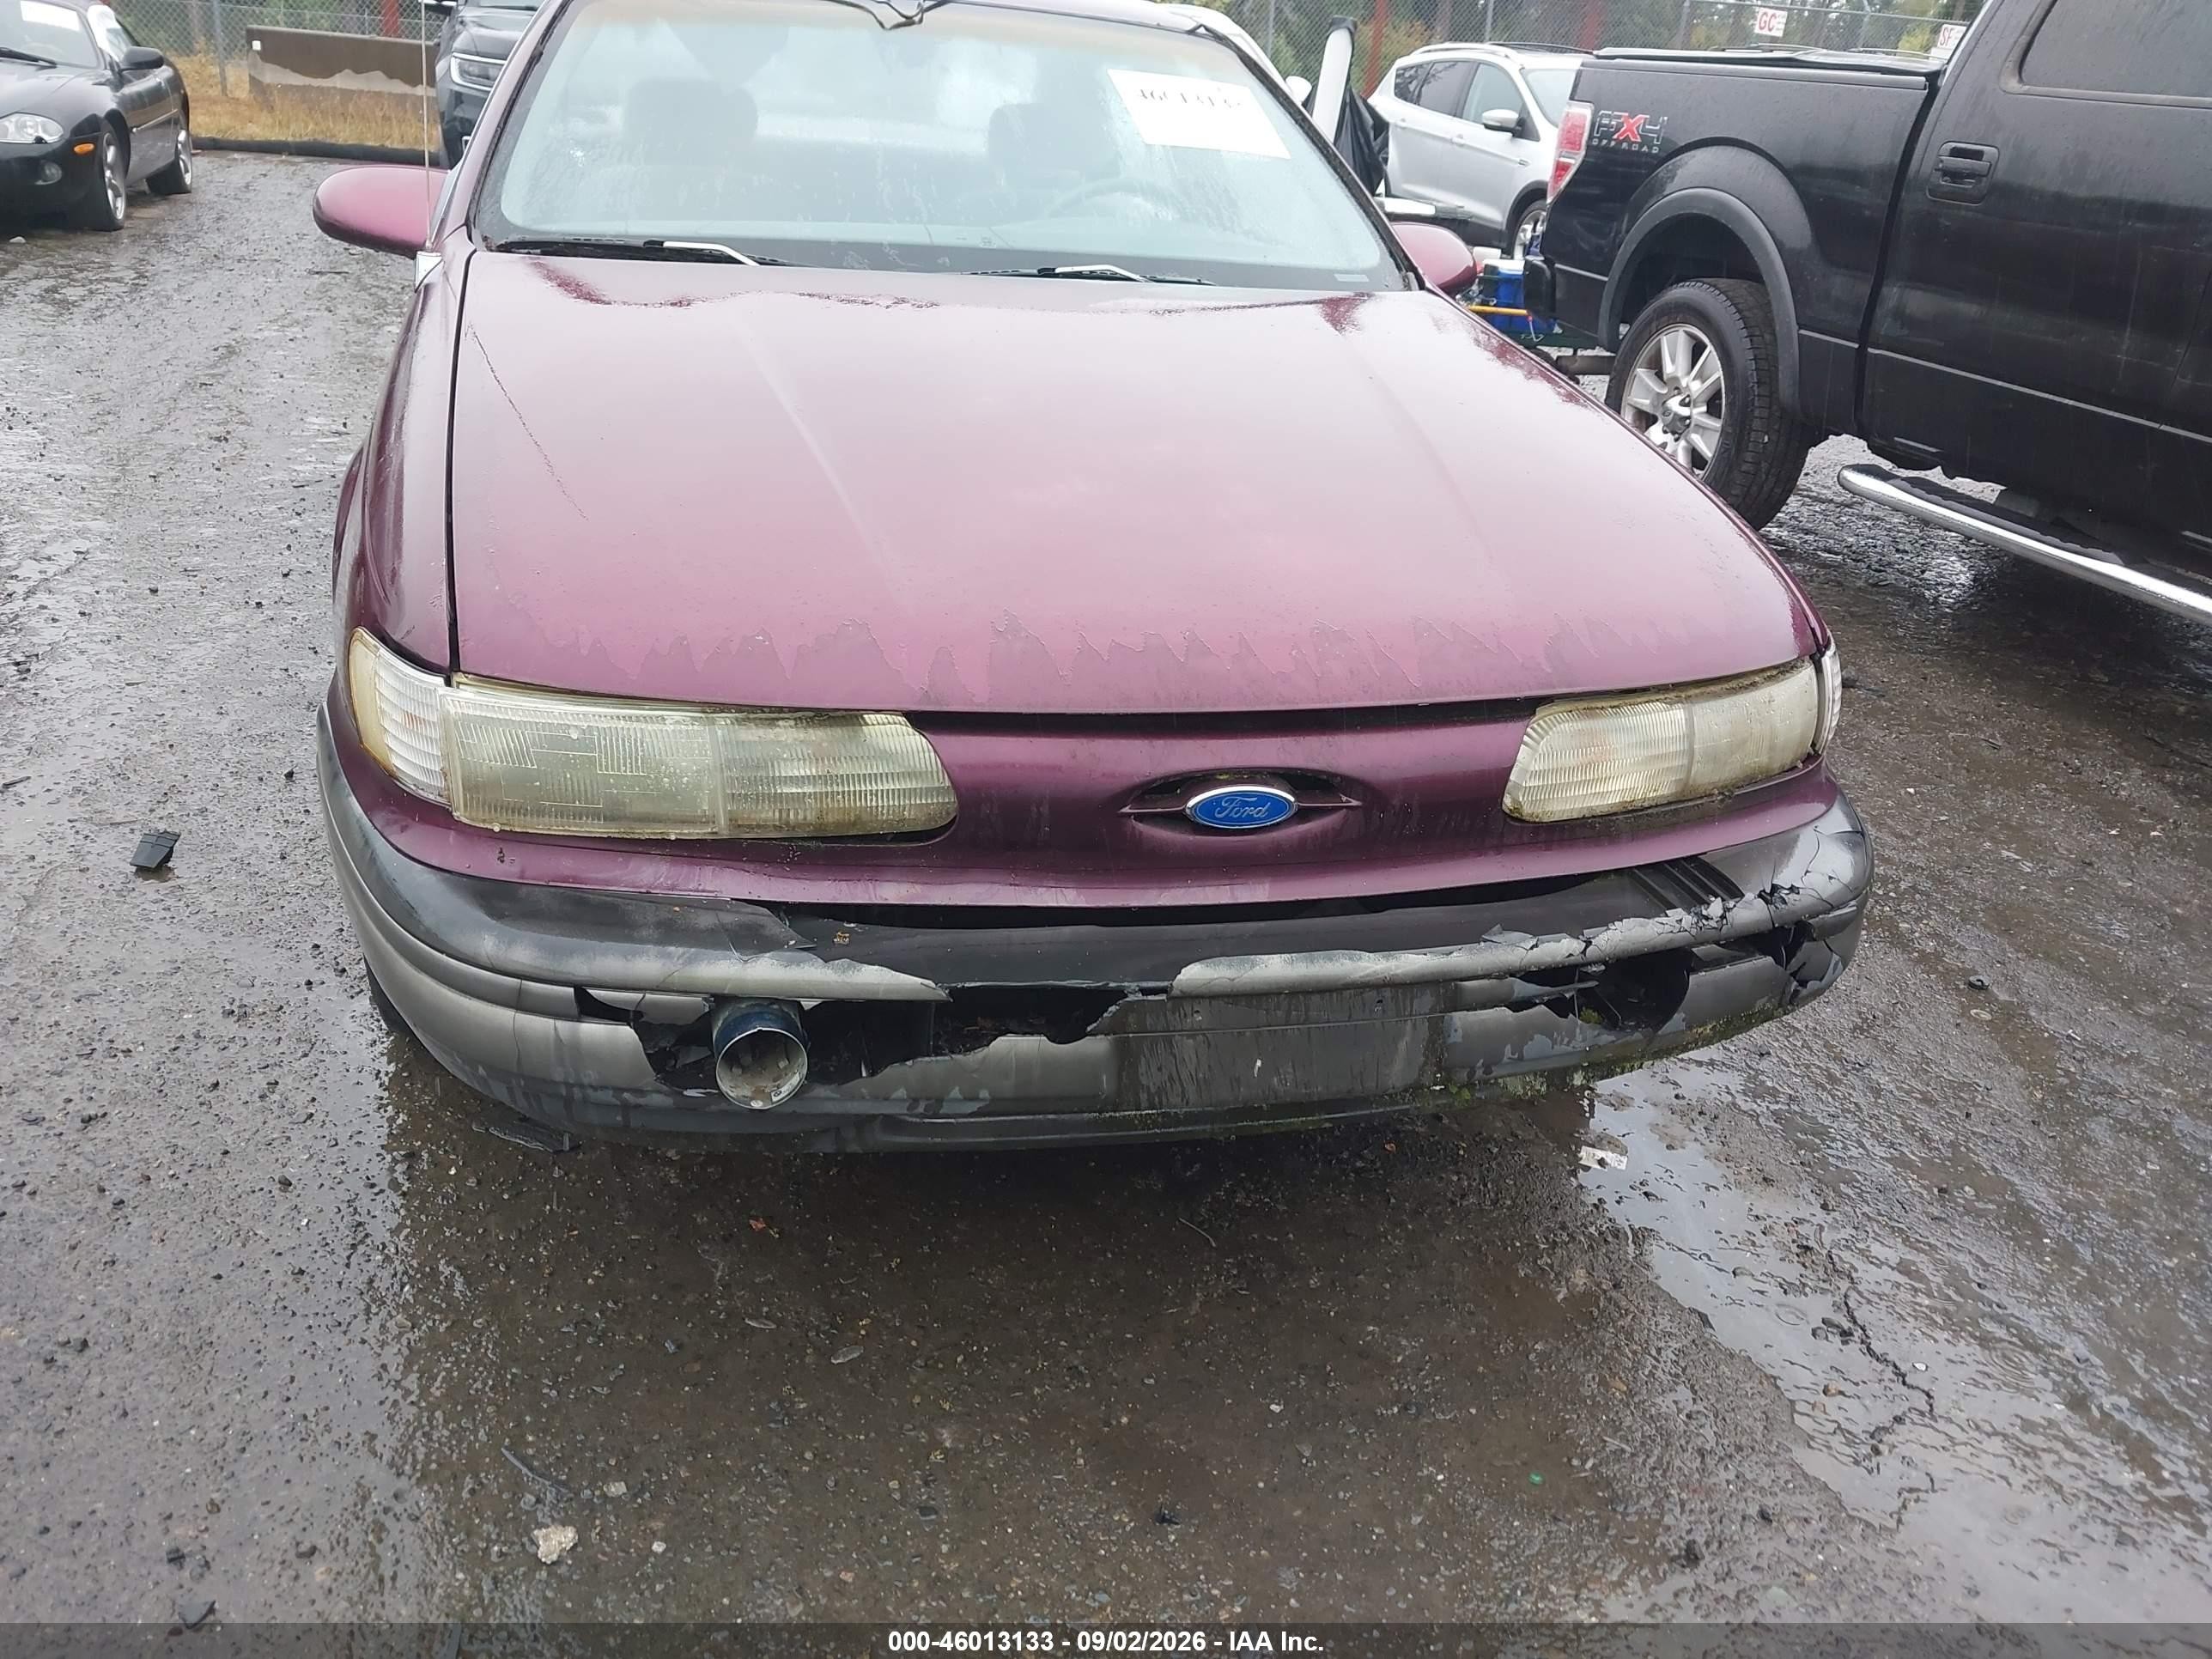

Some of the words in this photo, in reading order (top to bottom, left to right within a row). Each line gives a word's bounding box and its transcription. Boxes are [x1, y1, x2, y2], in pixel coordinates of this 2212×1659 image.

[1758, 11, 1777, 32] GC
[1940, 27, 1955, 46] SF
[1593, 109, 1668, 144] FX4
[1592, 138, 1616, 148] OFF
[1620, 142, 1660, 154] ROAD
[1214, 796, 1271, 818] Ford
